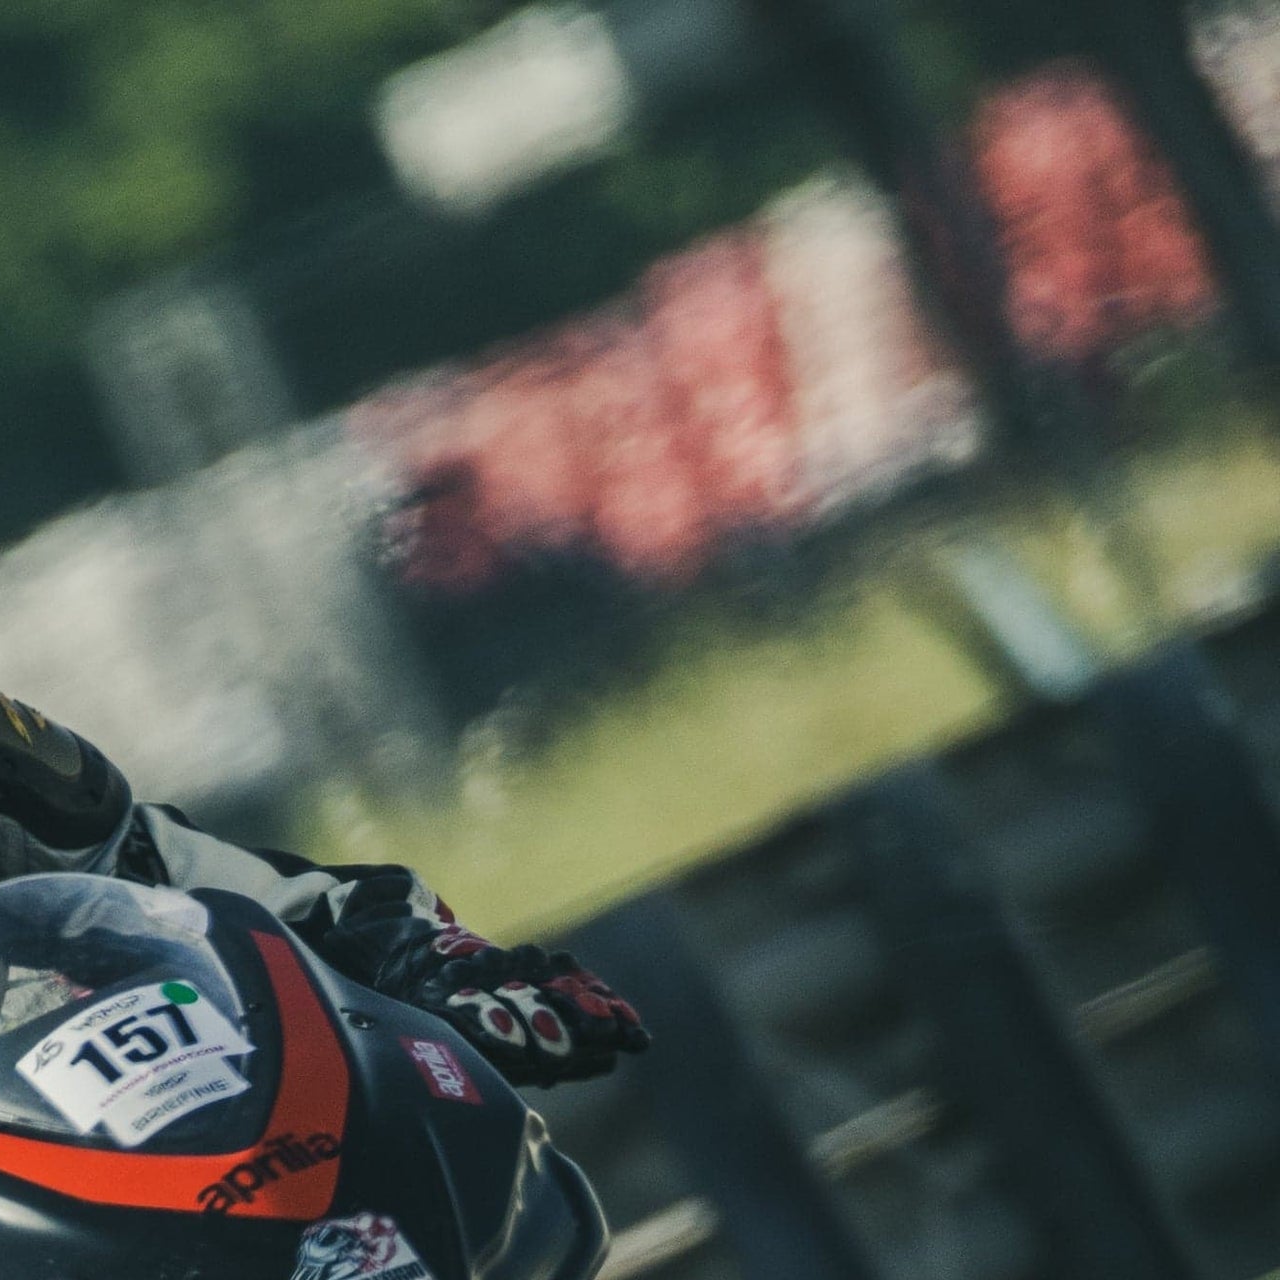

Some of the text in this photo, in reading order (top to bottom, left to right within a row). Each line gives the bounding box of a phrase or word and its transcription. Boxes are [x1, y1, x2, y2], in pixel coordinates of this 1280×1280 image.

[69, 1002, 199, 1084] 157
[413, 1041, 464, 1097] aprilia
[197, 1132, 342, 1213] aprilia
